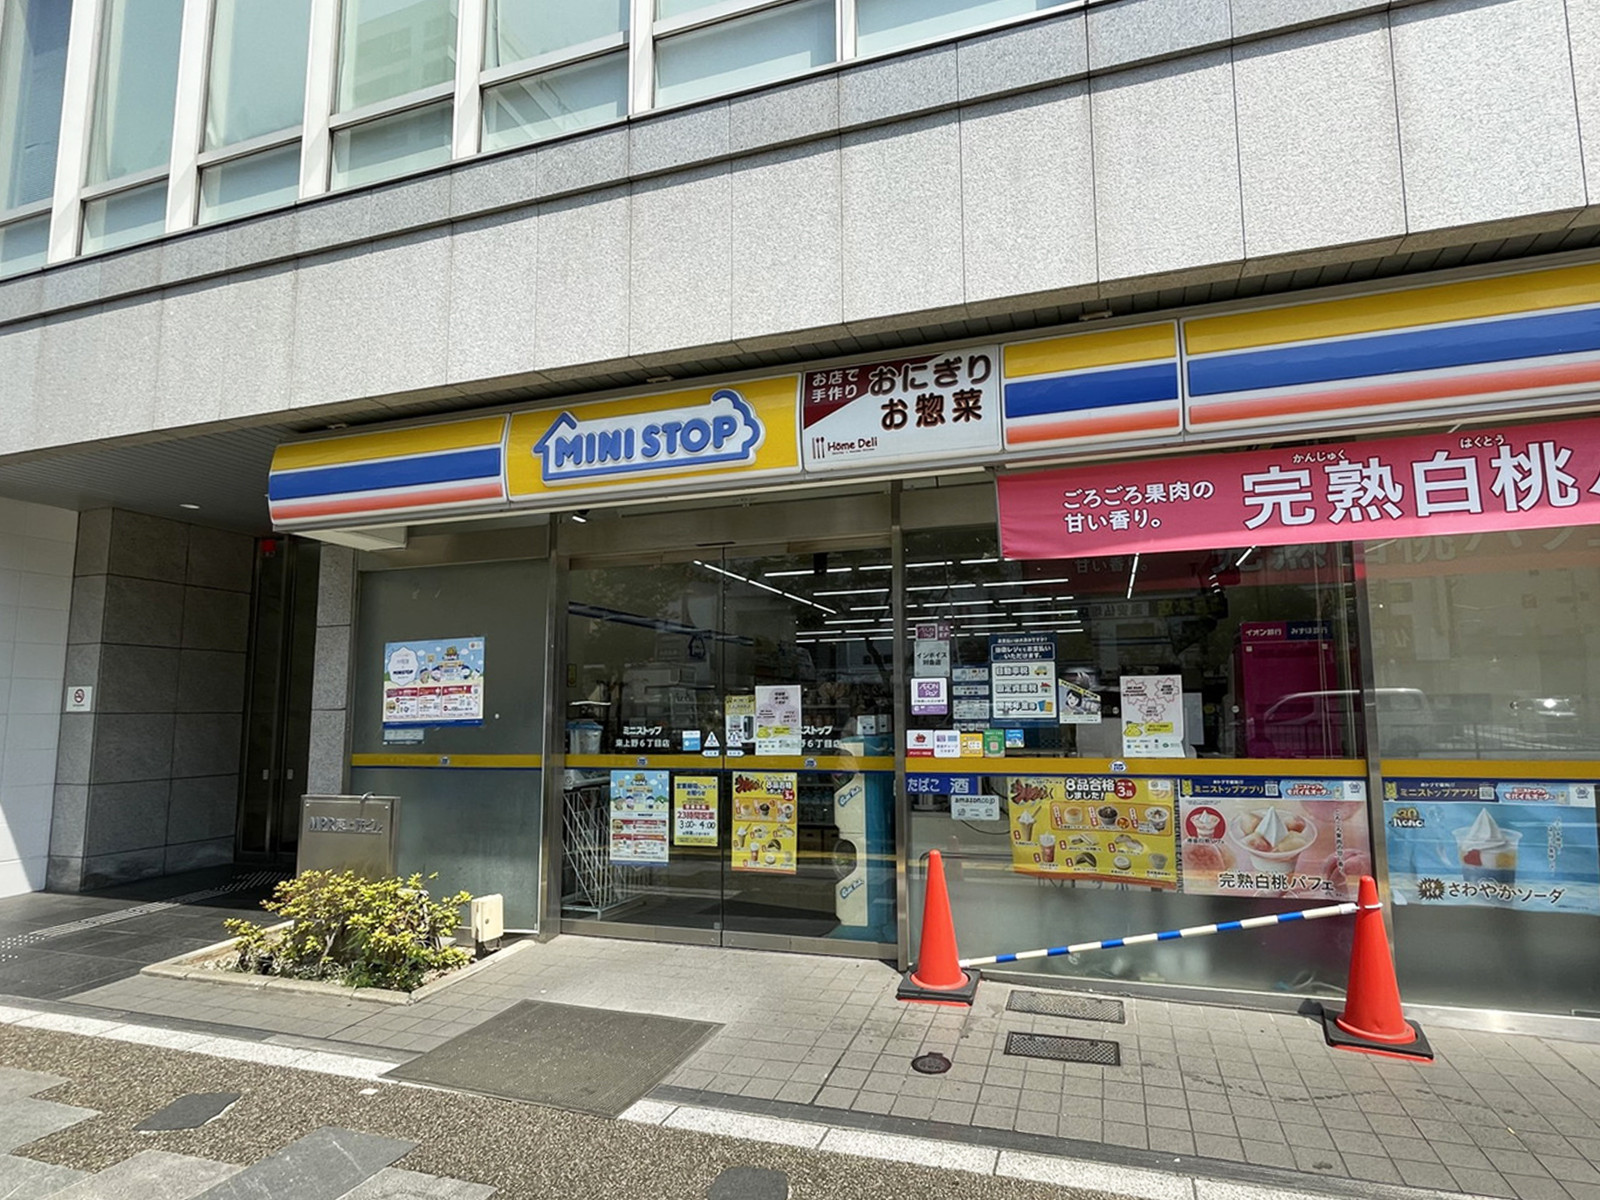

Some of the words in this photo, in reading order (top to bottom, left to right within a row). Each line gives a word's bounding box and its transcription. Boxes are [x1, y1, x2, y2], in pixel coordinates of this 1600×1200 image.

[811, 369, 859, 387] お店で
[867, 354, 992, 395] おにぎり
[811, 384, 858, 404] 手作り
[879, 389, 983, 430] お惣菜
[554, 427, 635, 469] MINI
[639, 414, 738, 462] STOP
[827, 440, 855, 451] Home
[858, 436, 878, 448] Deli
[1459, 434, 1506, 449] はくとう
[1291, 448, 1347, 464] かんじゅく
[1062, 480, 1215, 509] ごろごろ果肉の
[1064, 506, 1163, 533] 甘い香り。
[1245, 628, 1282, 637] イオン銀行
[1291, 626, 1328, 635] みずほ銀行
[916, 651, 948, 659] インボイス
[995, 665, 1030, 676] 自動車税
[622, 726, 662, 736] ミニストップ
[615, 738, 671, 749] 東上野6丁目店
[907, 778, 940, 792] たばこ
[949, 778, 970, 794] 酒
[1065, 777, 1116, 791] 8品合格
[1194, 785, 1264, 794] ミニストップアプリ
[1065, 790, 1106, 800] しました!
[1400, 787, 1479, 798] ミニストップアプリ
[954, 797, 996, 805] amazon.co.jp
[1390, 818, 1426, 828] ハロハロ
[1218, 872, 1335, 891] 完熟白桃パフェ
[1448, 881, 1565, 904] さわやかソーダ
